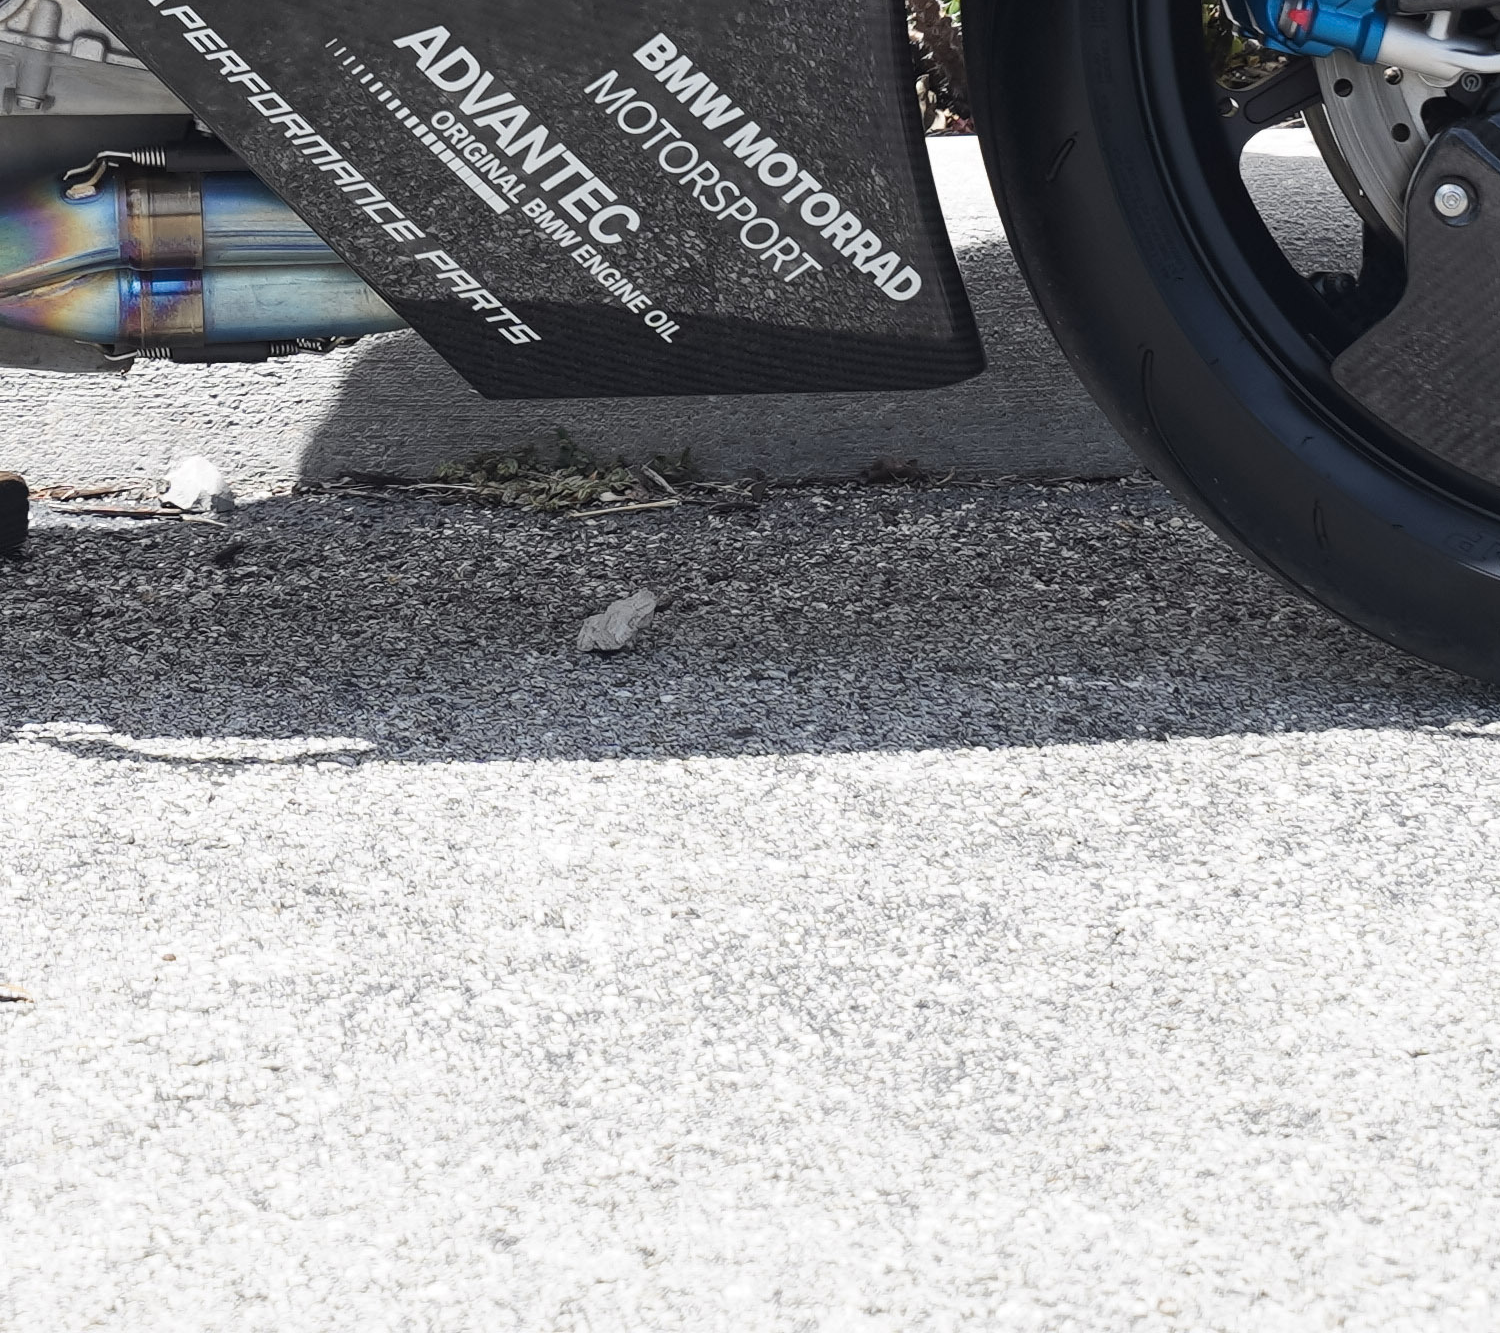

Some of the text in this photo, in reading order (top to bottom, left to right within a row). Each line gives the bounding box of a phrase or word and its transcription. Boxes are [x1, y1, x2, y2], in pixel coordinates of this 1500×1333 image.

[160, 5, 425, 242] PERFORMANCE
[415, 250, 542, 345] PARTS
[393, 25, 640, 244] ADVANTEC
[431, 111, 681, 344] ORIGINAL BMW ENGINE OIL
[584, 70, 823, 283] MOTORSPORT
[633, 33, 922, 301] BMW MOTORRAD
